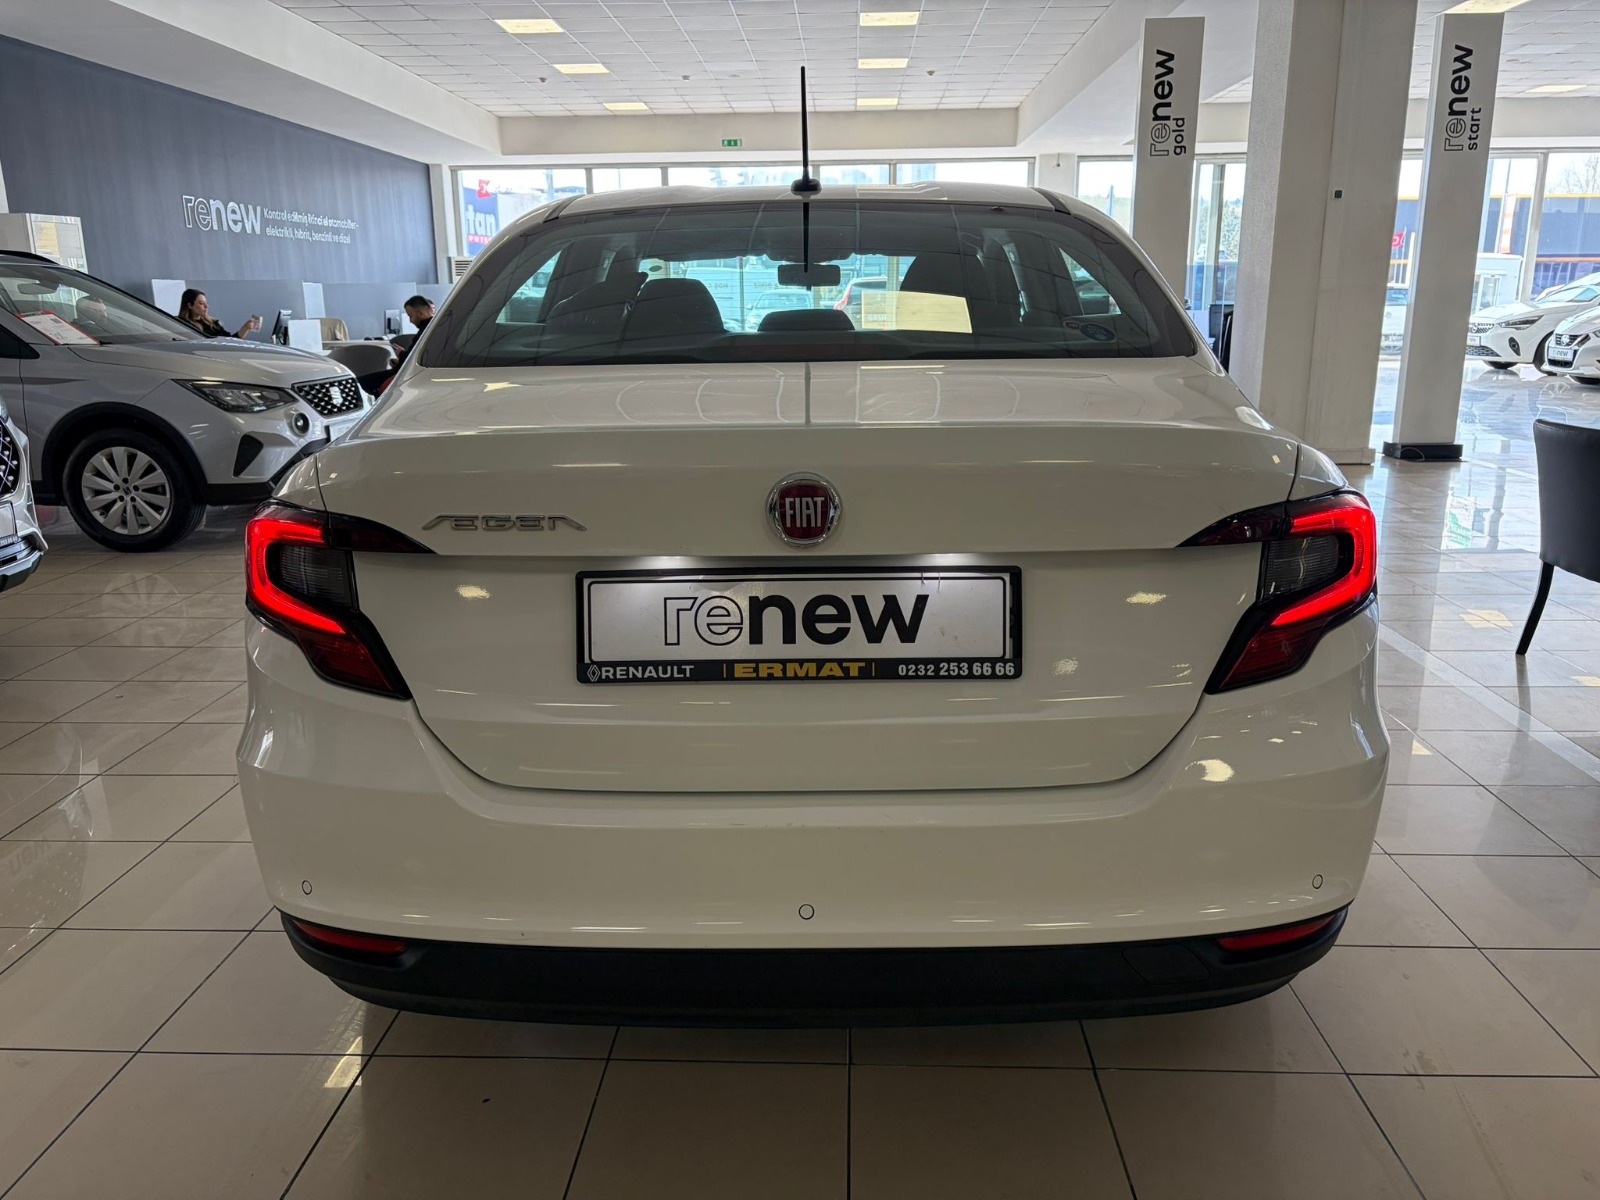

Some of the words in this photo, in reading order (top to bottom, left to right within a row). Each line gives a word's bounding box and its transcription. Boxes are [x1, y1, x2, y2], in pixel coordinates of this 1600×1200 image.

[1150, 49, 1175, 156] renew
[1444, 44, 1473, 151] renew
[1172, 117, 1186, 156] gold
[1468, 107, 1481, 151] start
[182, 195, 261, 235] renew
[263, 207, 287, 221] Kontrol
[266, 225, 294, 240] elektrikli,
[785, 497, 825, 528] FIAT
[663, 594, 930, 646] renew
[601, 665, 694, 679] RENAULT
[734, 662, 865, 678] ERMAT
[898, 664, 935, 676] 0232
[939, 662, 969, 676] 253
[972, 662, 992, 676] 66
[995, 662, 1015, 676] 66
